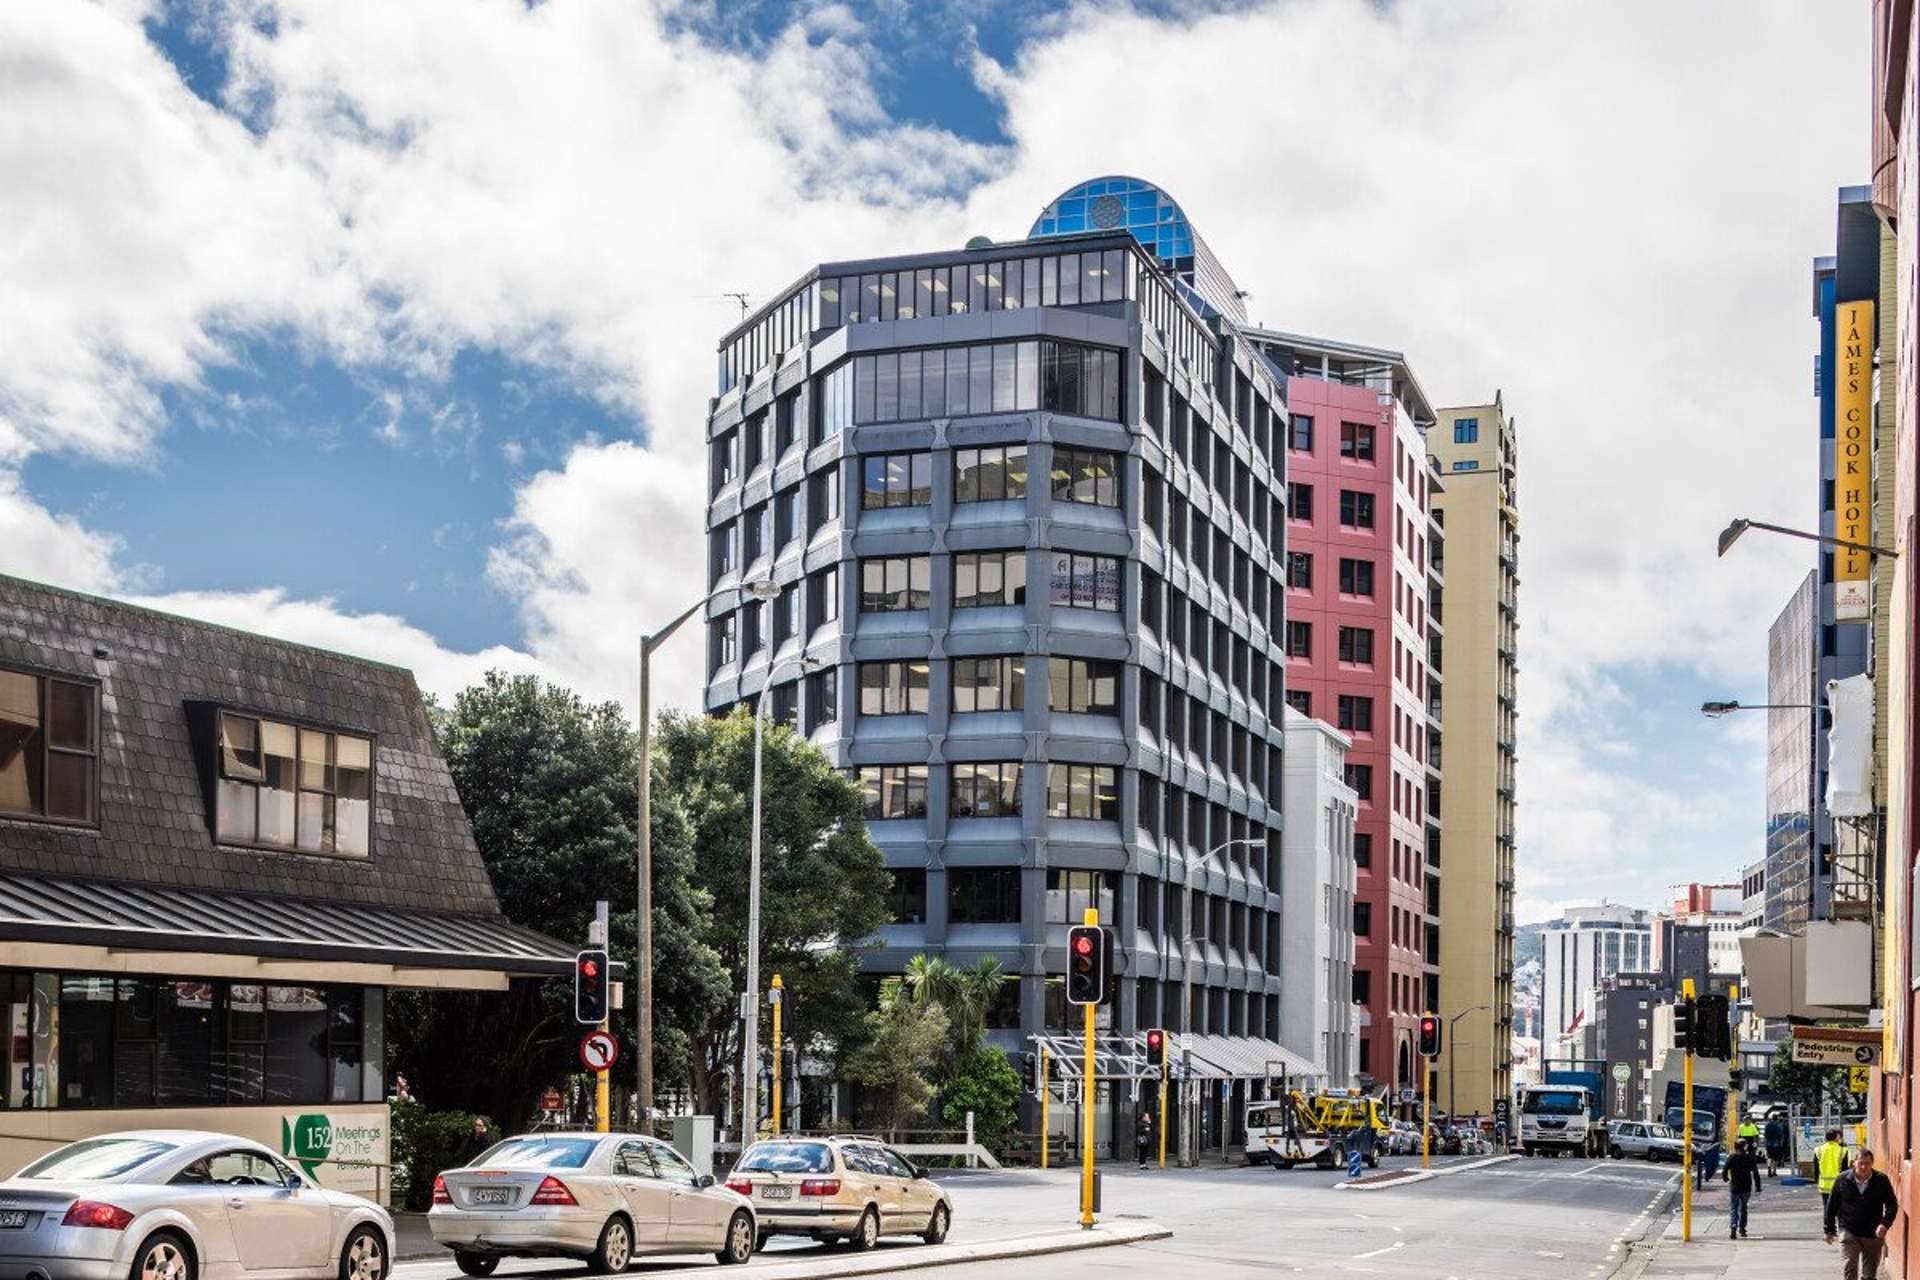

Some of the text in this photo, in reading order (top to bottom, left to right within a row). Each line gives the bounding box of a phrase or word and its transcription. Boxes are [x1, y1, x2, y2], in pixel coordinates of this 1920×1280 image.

[1846, 310, 1862, 393] JAMES
[1846, 408, 1860, 474] COOK
[1798, 1043, 1854, 1053] Pedestrian
[1798, 1050, 1825, 1060] Entry
[306, 1127, 332, 1149] 152
[336, 1126, 381, 1141] Meetings
[336, 1141, 371, 1155] On The
